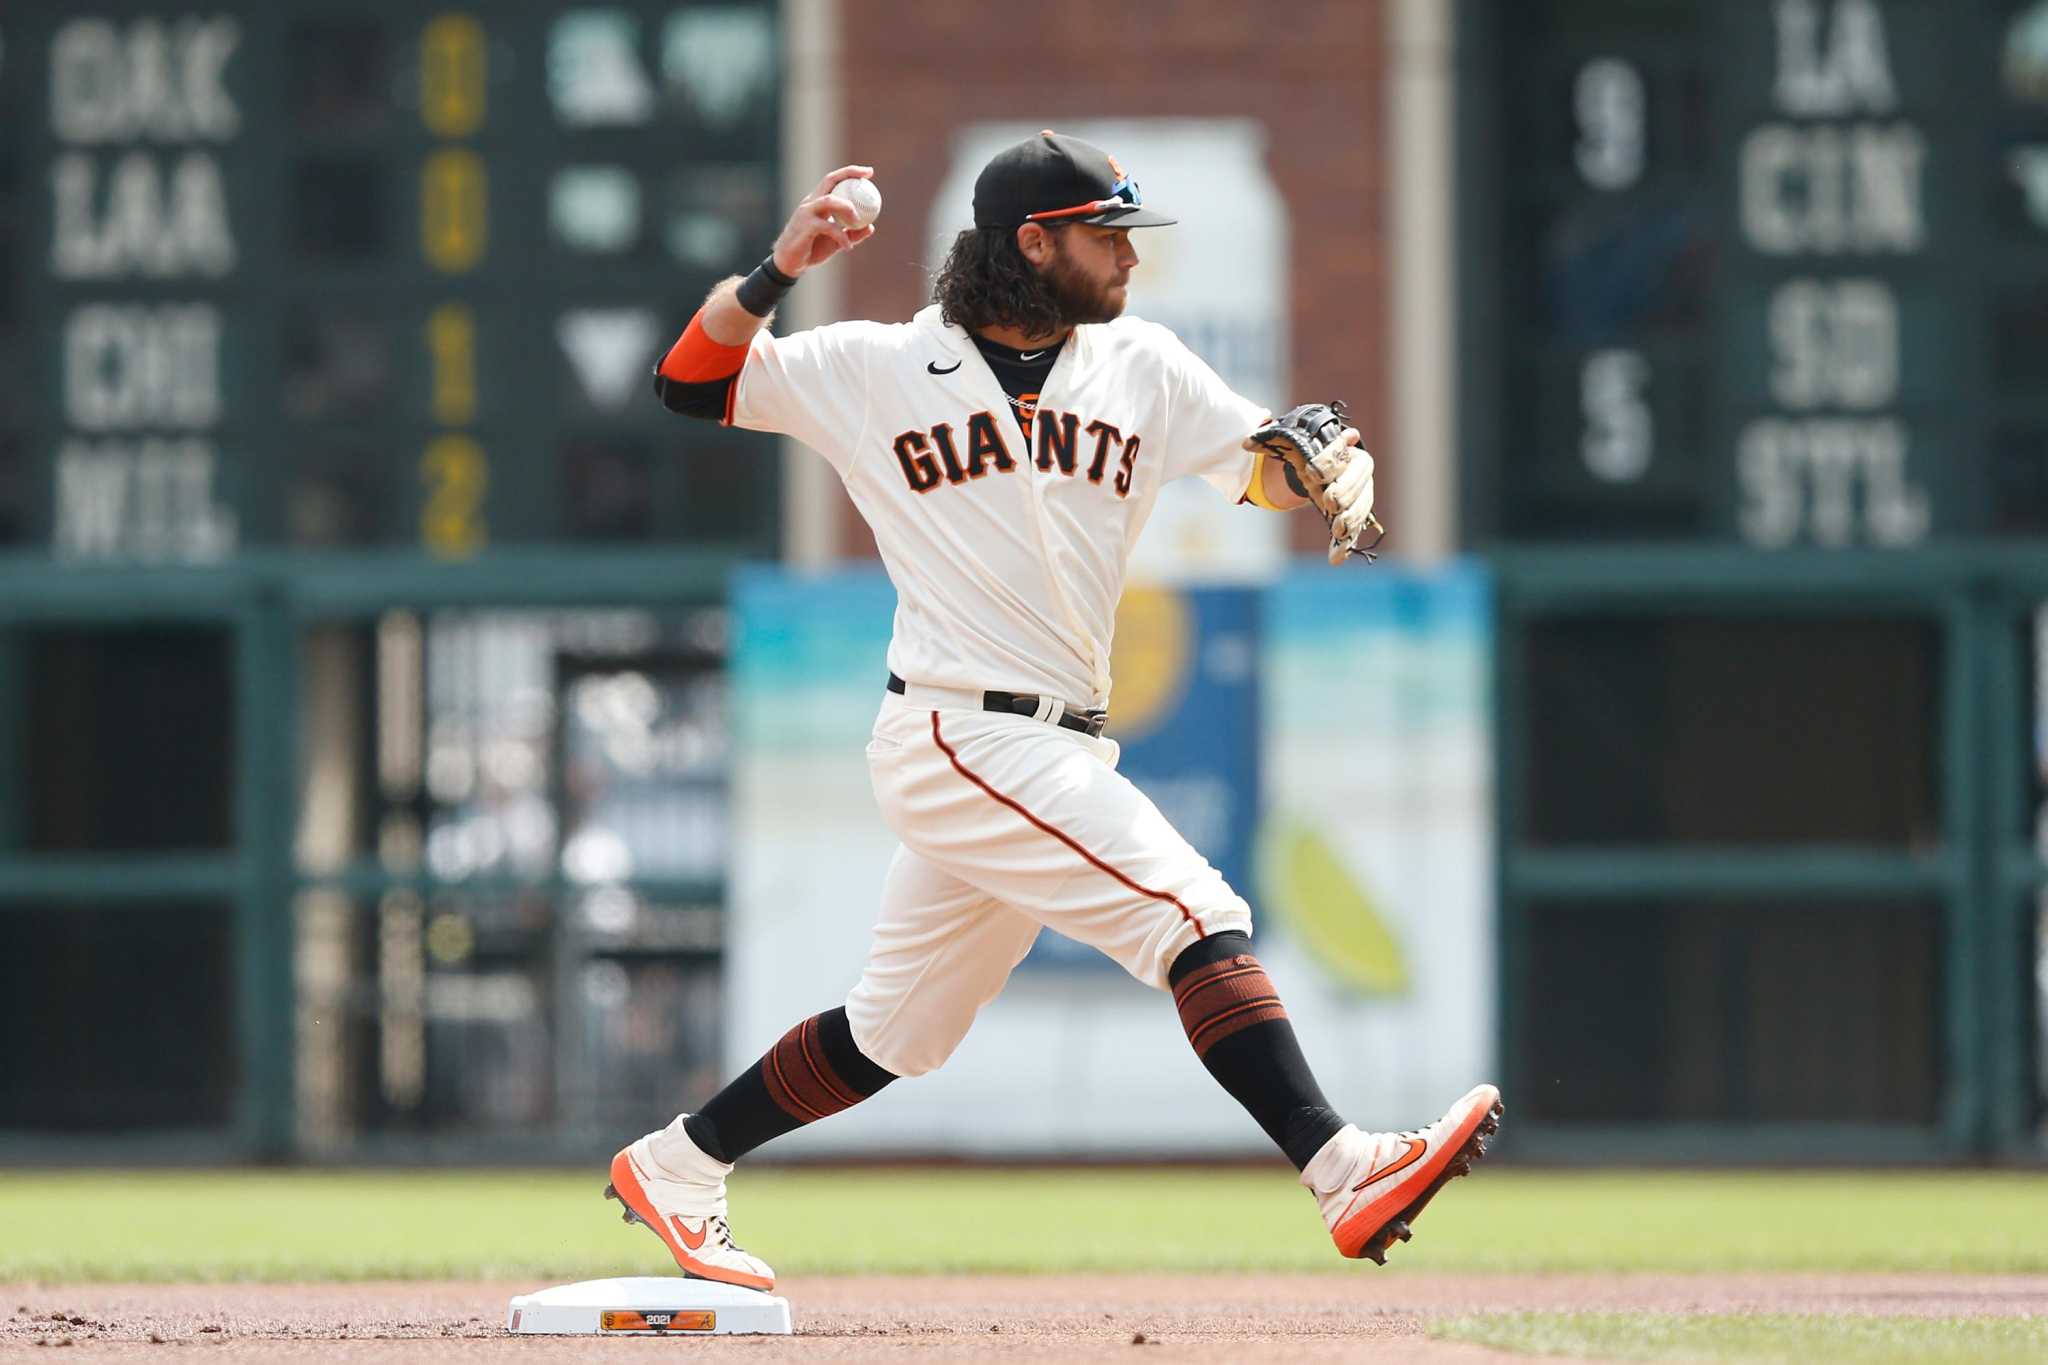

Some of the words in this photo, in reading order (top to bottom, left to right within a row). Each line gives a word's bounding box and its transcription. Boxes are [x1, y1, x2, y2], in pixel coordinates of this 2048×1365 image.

[50, 17, 240, 142] OAK
[1773, 0, 1898, 115] LA
[51, 150, 238, 280] LAA
[1738, 121, 1926, 256] CIN
[64, 303, 222, 430] CHI
[428, 303, 477, 427] 1
[1770, 277, 1898, 410] SD
[893, 408, 1141, 499] GIANTS
[1580, 348, 1654, 483] 5
[420, 434, 488, 563] 2
[1737, 415, 1932, 549] STL
[646, 1314, 671, 1325] 2021
